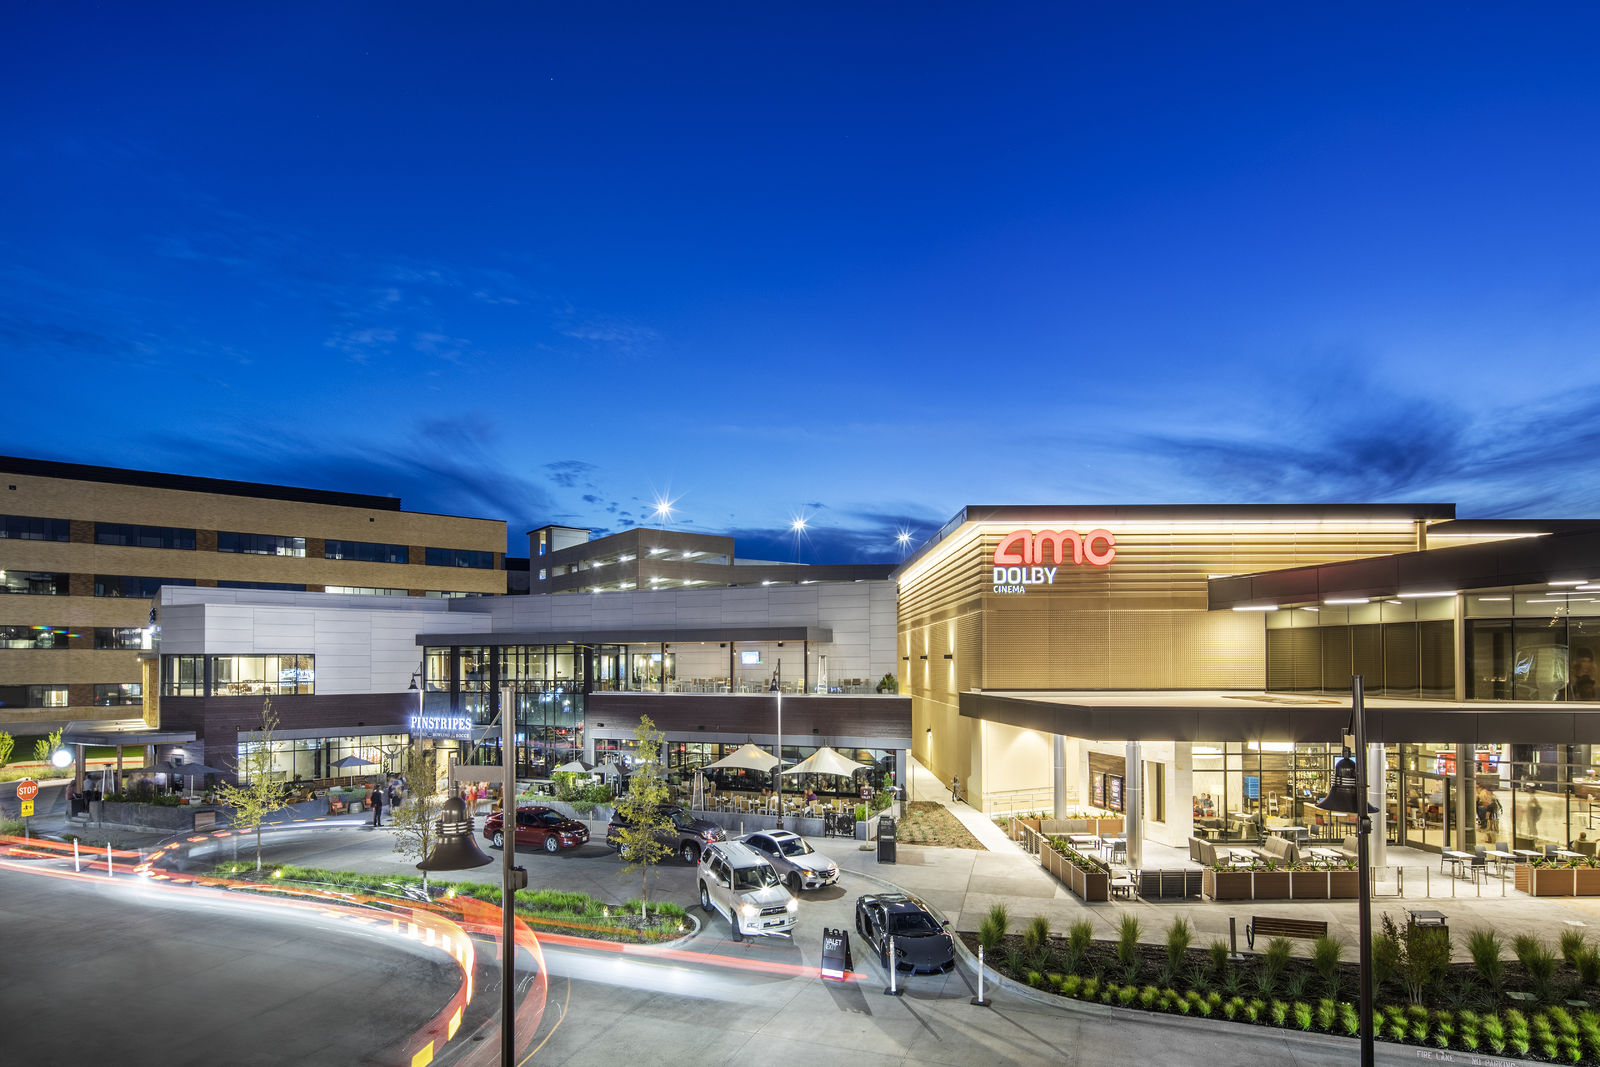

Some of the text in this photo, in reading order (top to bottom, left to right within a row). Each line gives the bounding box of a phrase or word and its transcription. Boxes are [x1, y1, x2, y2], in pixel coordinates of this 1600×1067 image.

[993, 567, 1058, 585] DOLBY
[993, 585, 1026, 594] CINEMA
[410, 716, 472, 730] PINSTRIPES
[18, 786, 36, 795] STOP
[826, 938, 842, 946] VALET
[1416, 1050, 1433, 1059] FIRE
[1436, 1051, 1456, 1063] LANE
[1471, 1057, 1482, 1066] NO
